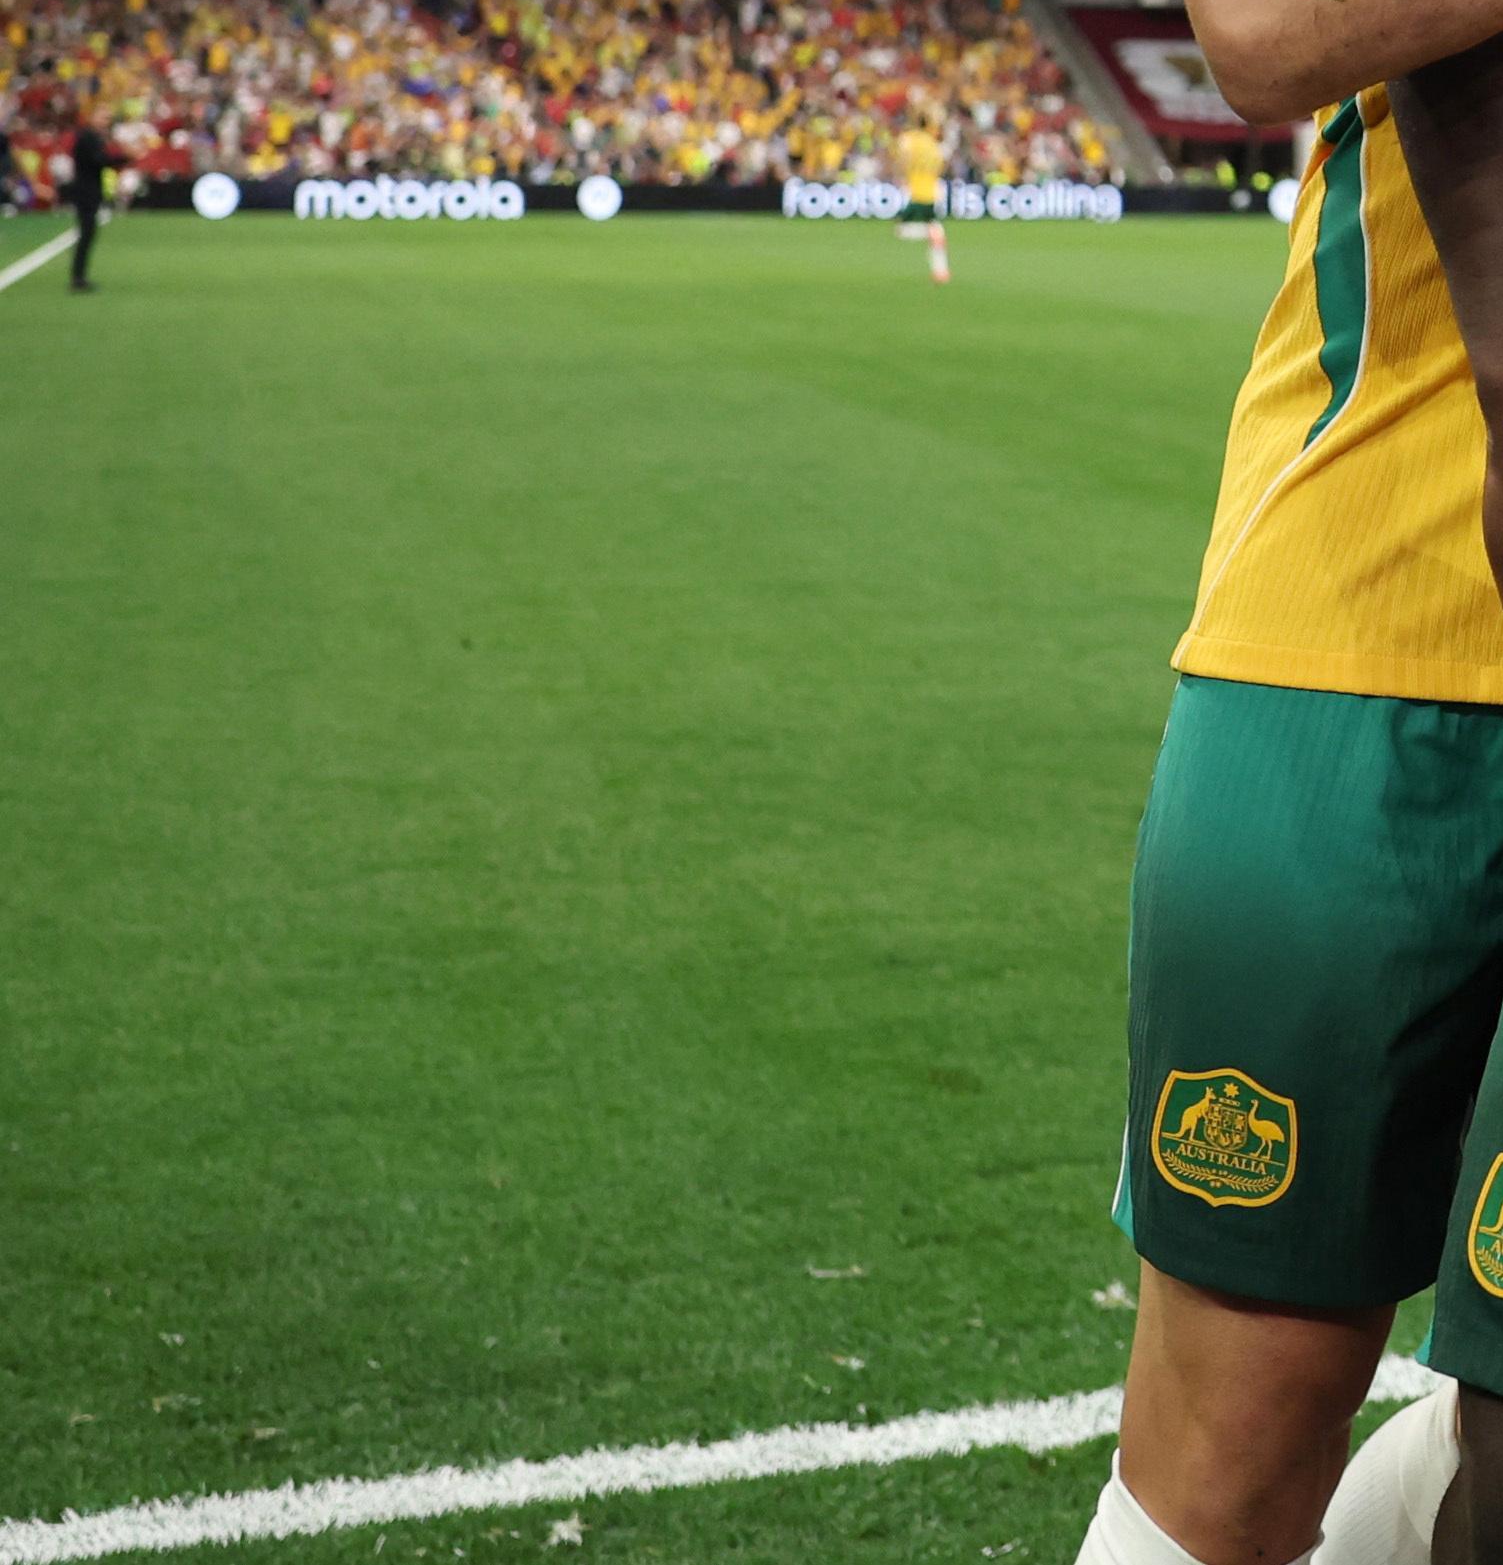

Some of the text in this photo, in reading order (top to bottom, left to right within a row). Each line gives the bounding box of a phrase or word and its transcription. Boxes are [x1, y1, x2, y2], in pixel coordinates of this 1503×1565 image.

[293, 172, 524, 221] motorola
[985, 178, 1122, 223] calling
[1175, 1143, 1268, 1175] AUSTRALIA
